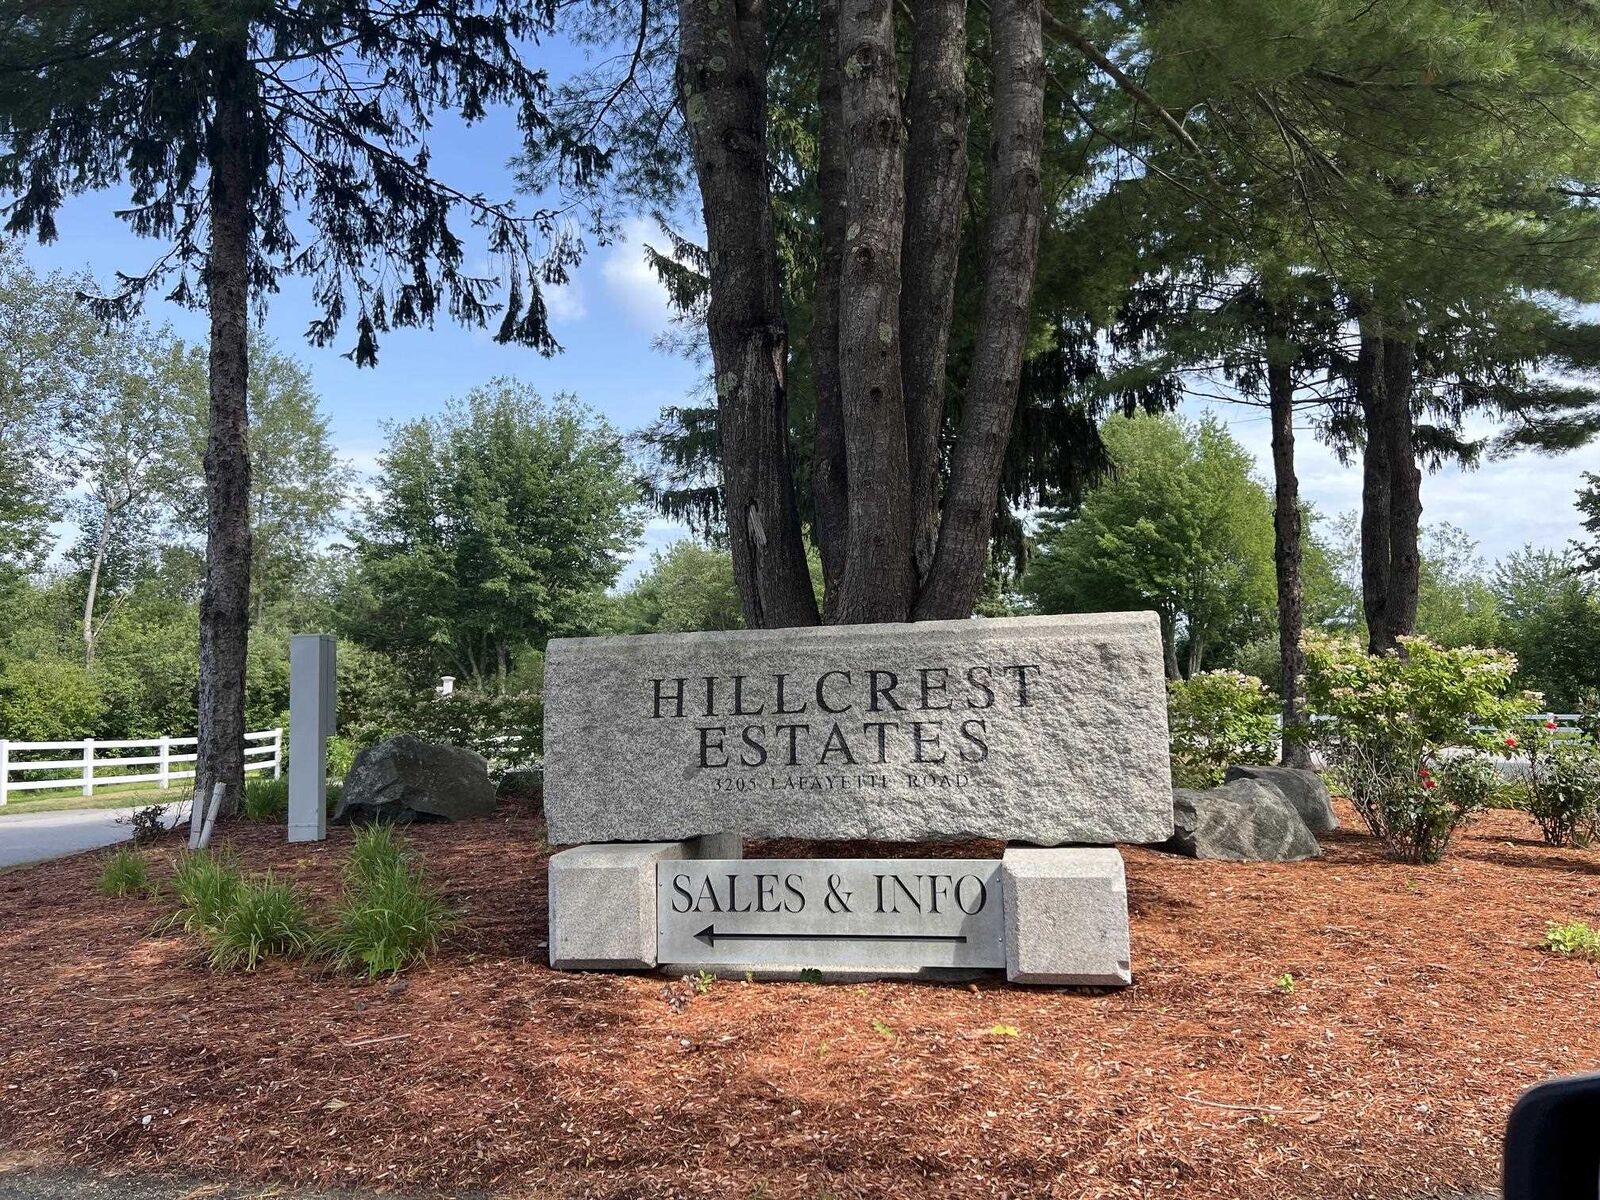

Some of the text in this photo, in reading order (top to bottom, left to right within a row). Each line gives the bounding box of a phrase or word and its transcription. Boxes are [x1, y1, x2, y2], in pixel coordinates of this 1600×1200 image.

[649, 665, 1041, 719] HILLCREST
[696, 719, 990, 769] ESTATES
[713, 777, 757, 793] 3205
[907, 773, 970, 790] ROAD
[671, 873, 988, 916] SALES & INFO
